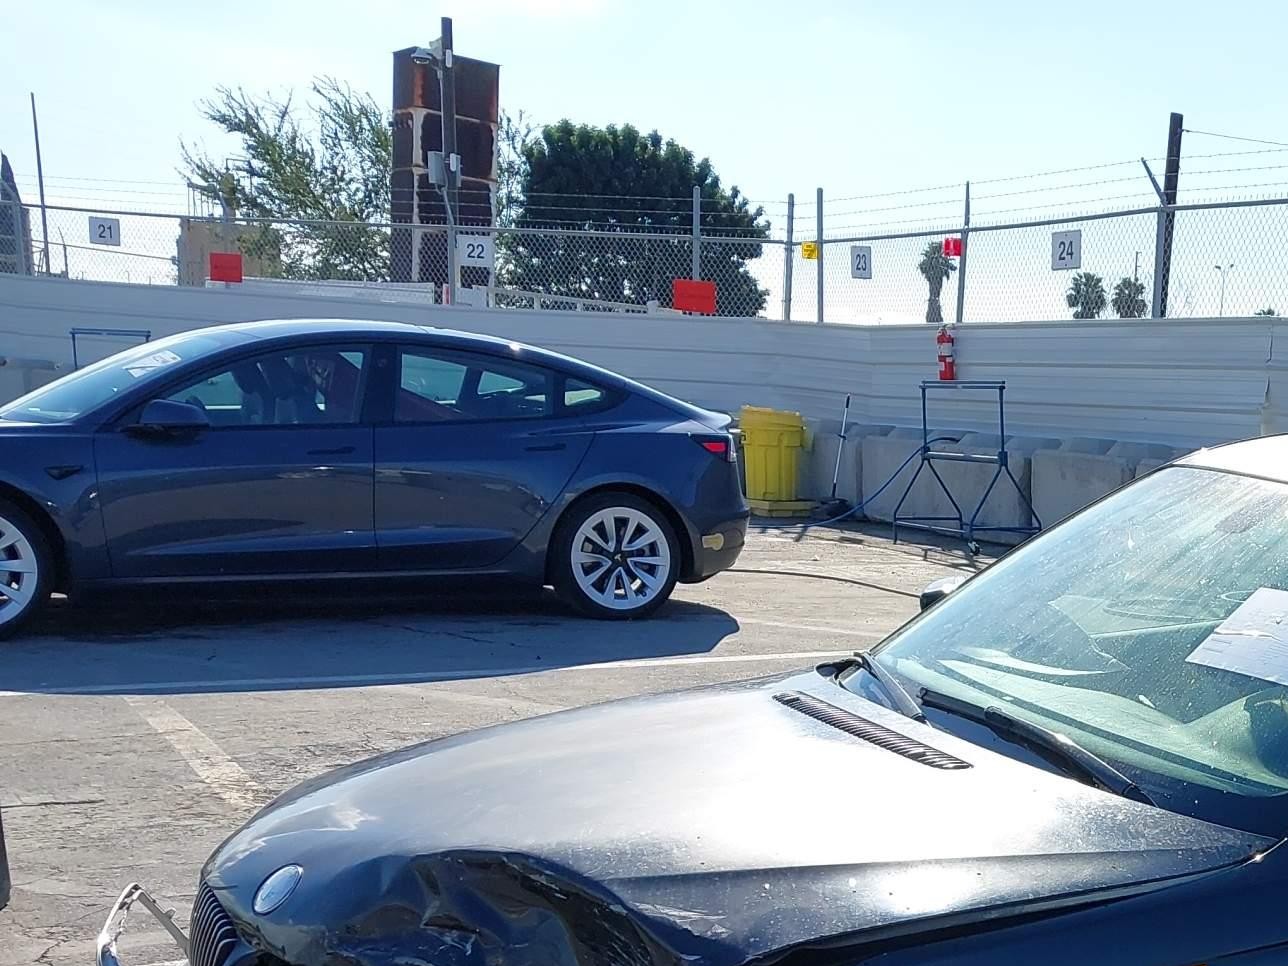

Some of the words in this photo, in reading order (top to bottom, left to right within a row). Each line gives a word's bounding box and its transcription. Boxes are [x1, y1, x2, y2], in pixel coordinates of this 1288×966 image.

[97, 223, 113, 239] 21
[466, 243, 485, 259] 22
[1058, 240, 1074, 261] 24
[855, 253, 867, 271] 23
